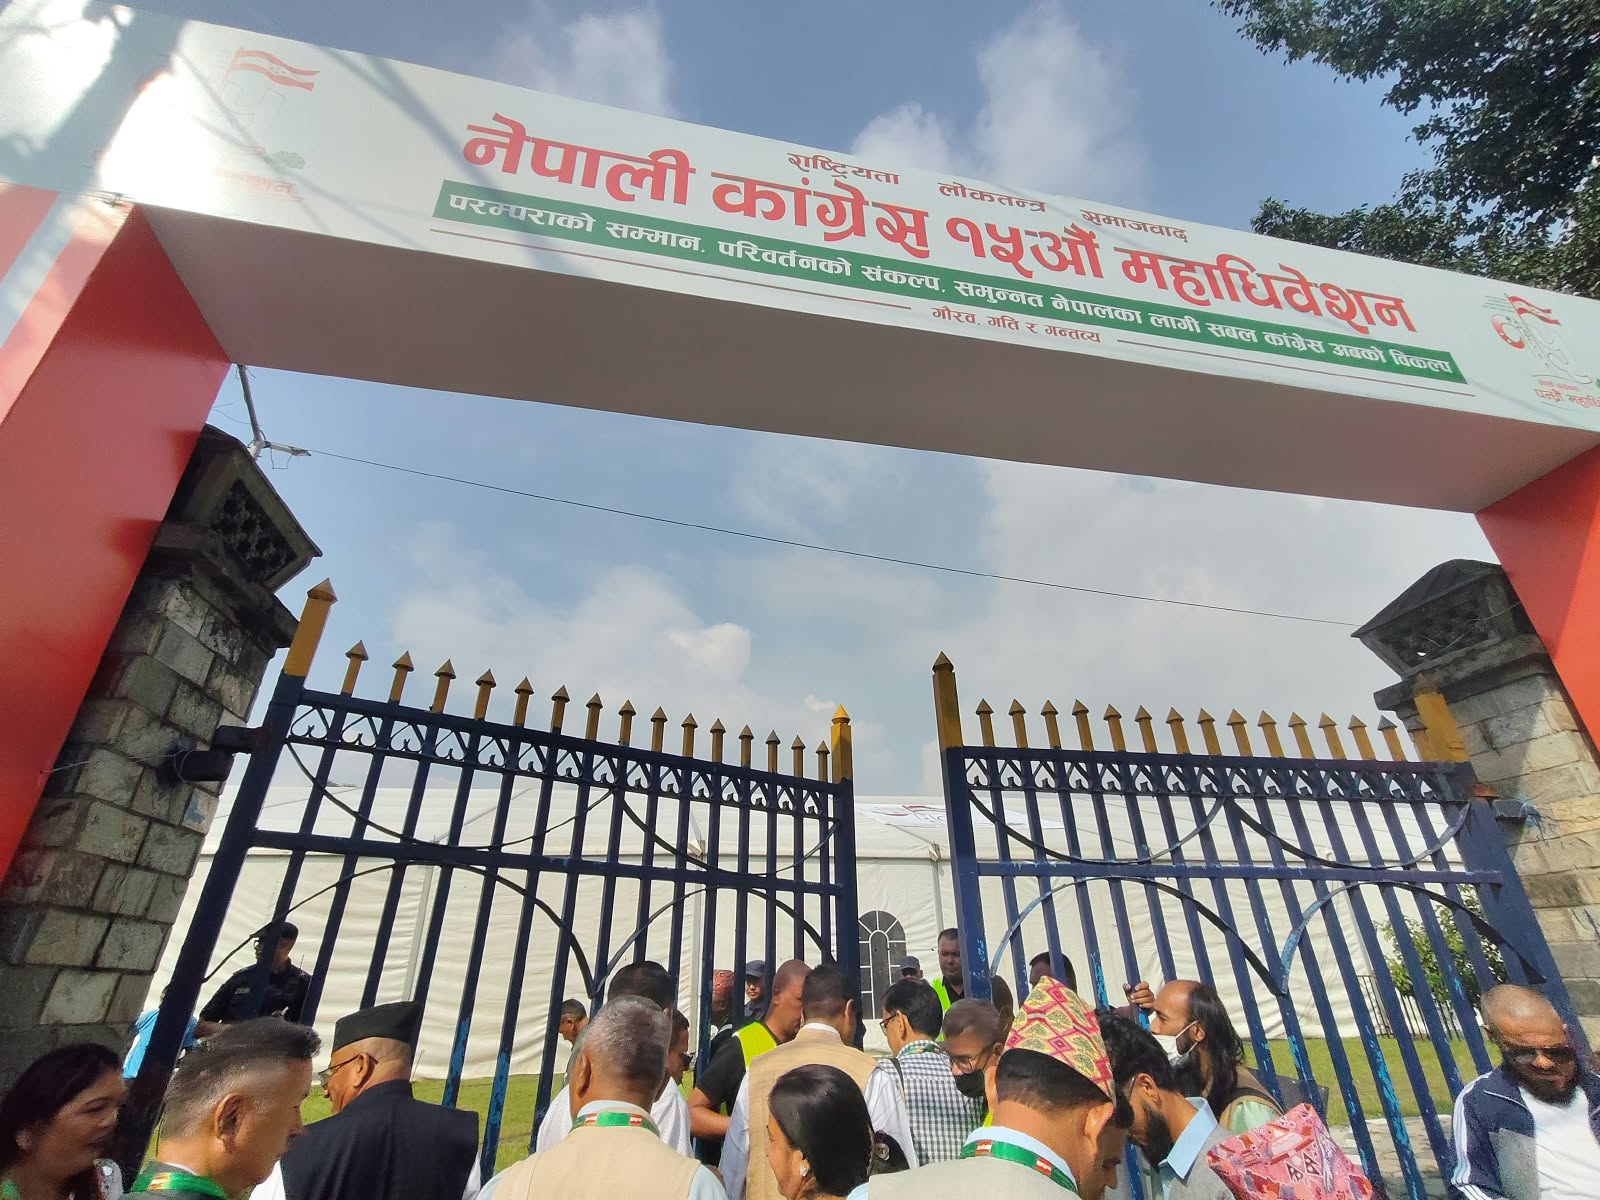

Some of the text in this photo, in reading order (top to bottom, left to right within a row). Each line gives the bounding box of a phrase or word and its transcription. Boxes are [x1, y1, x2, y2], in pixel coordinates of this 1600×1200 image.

[463, 113, 1417, 334] नेपाली कांग्रेस १५औं महाधिवेशन
[786, 152, 1188, 243] राष्ट्रियता लोकतन्त्र समाजवाद
[449, 192, 597, 233] परम्पराको
[718, 240, 852, 277] परिवर्तनको
[953, 280, 1044, 308] समुन्नत
[1050, 293, 1143, 324] नेपालका
[1148, 312, 1202, 334] लागी
[1207, 322, 1259, 343] सबल
[1263, 331, 1326, 354] कांग्रेस
[1332, 342, 1387, 364] अबको
[1391, 349, 1453, 374] विकल्प
[987, 315, 1020, 332] गति
[1025, 323, 1038, 334] र
[1044, 324, 1101, 344] गन्तव्य
